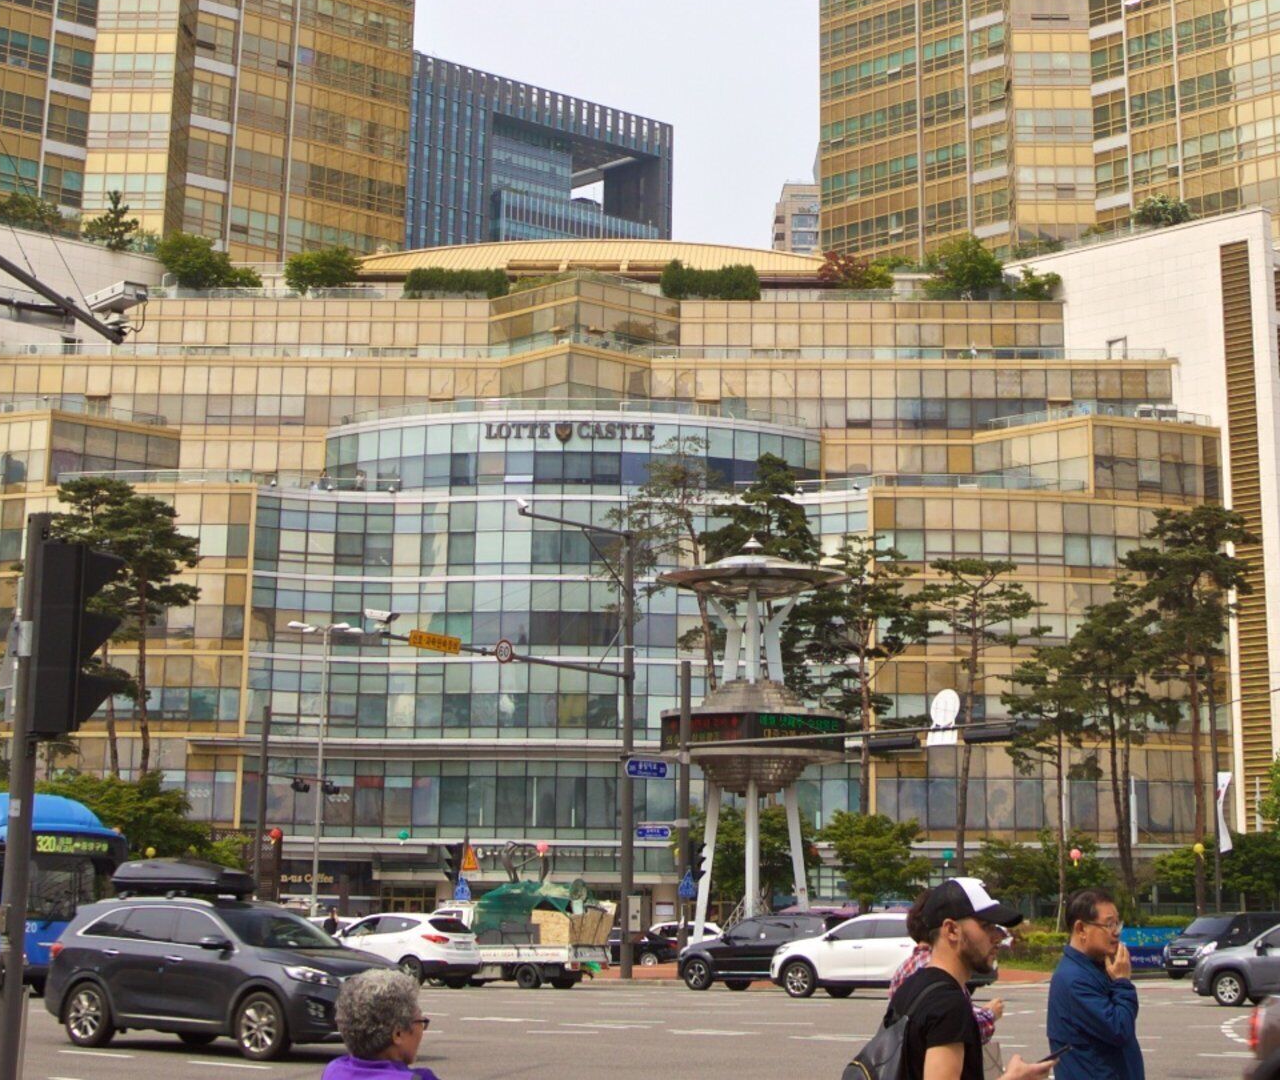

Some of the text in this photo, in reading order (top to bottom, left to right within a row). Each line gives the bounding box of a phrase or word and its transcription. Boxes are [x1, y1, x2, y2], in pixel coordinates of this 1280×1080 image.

[485, 422, 656, 441] LOTTE CASTLE
[499, 645, 509, 657] 60
[36, 835, 56, 852] 320
[26, 922, 38, 933] 20
